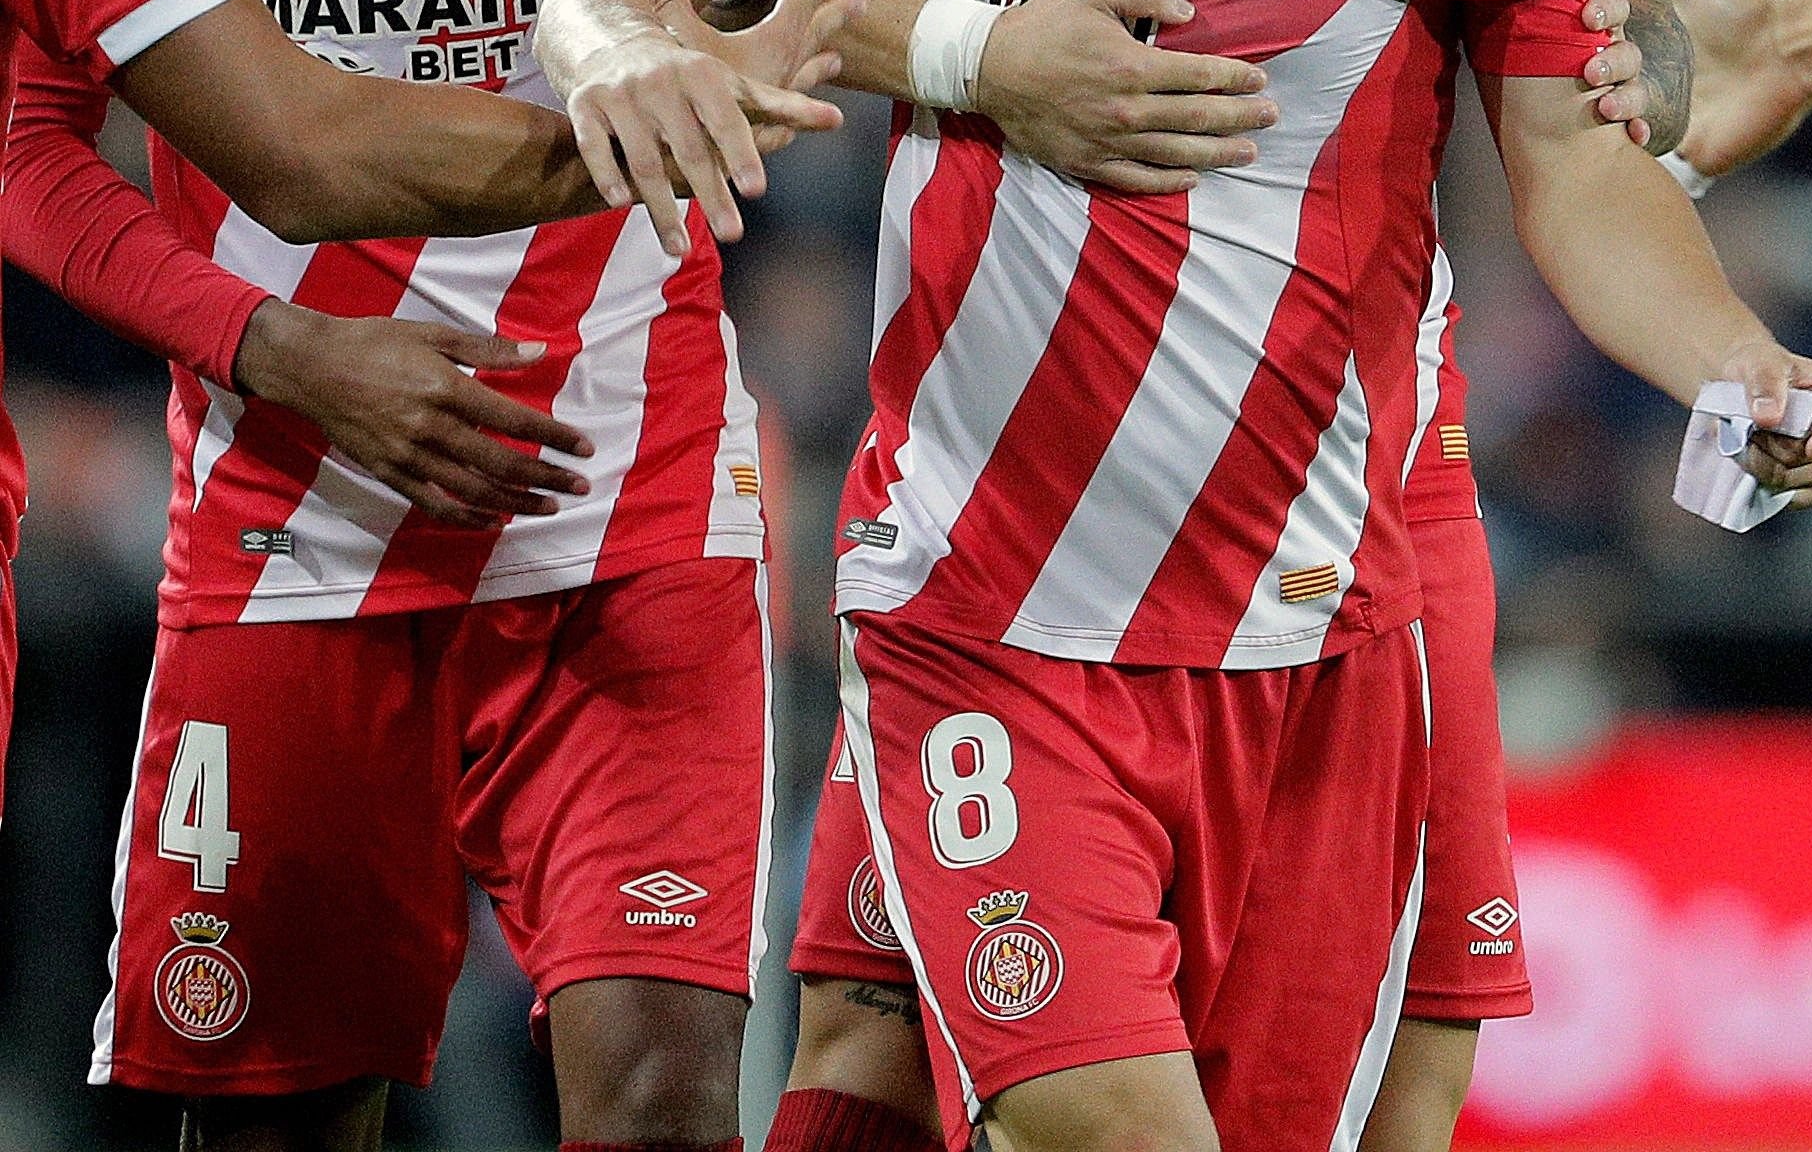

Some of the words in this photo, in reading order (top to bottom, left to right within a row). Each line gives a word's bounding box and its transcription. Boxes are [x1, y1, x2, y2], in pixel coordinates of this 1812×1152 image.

[410, 38, 520, 82] BET
[157, 719, 241, 893] 4
[920, 711, 1020, 870] 8
[625, 909, 697, 928] umbro
[1469, 937, 1514, 955] umbro
